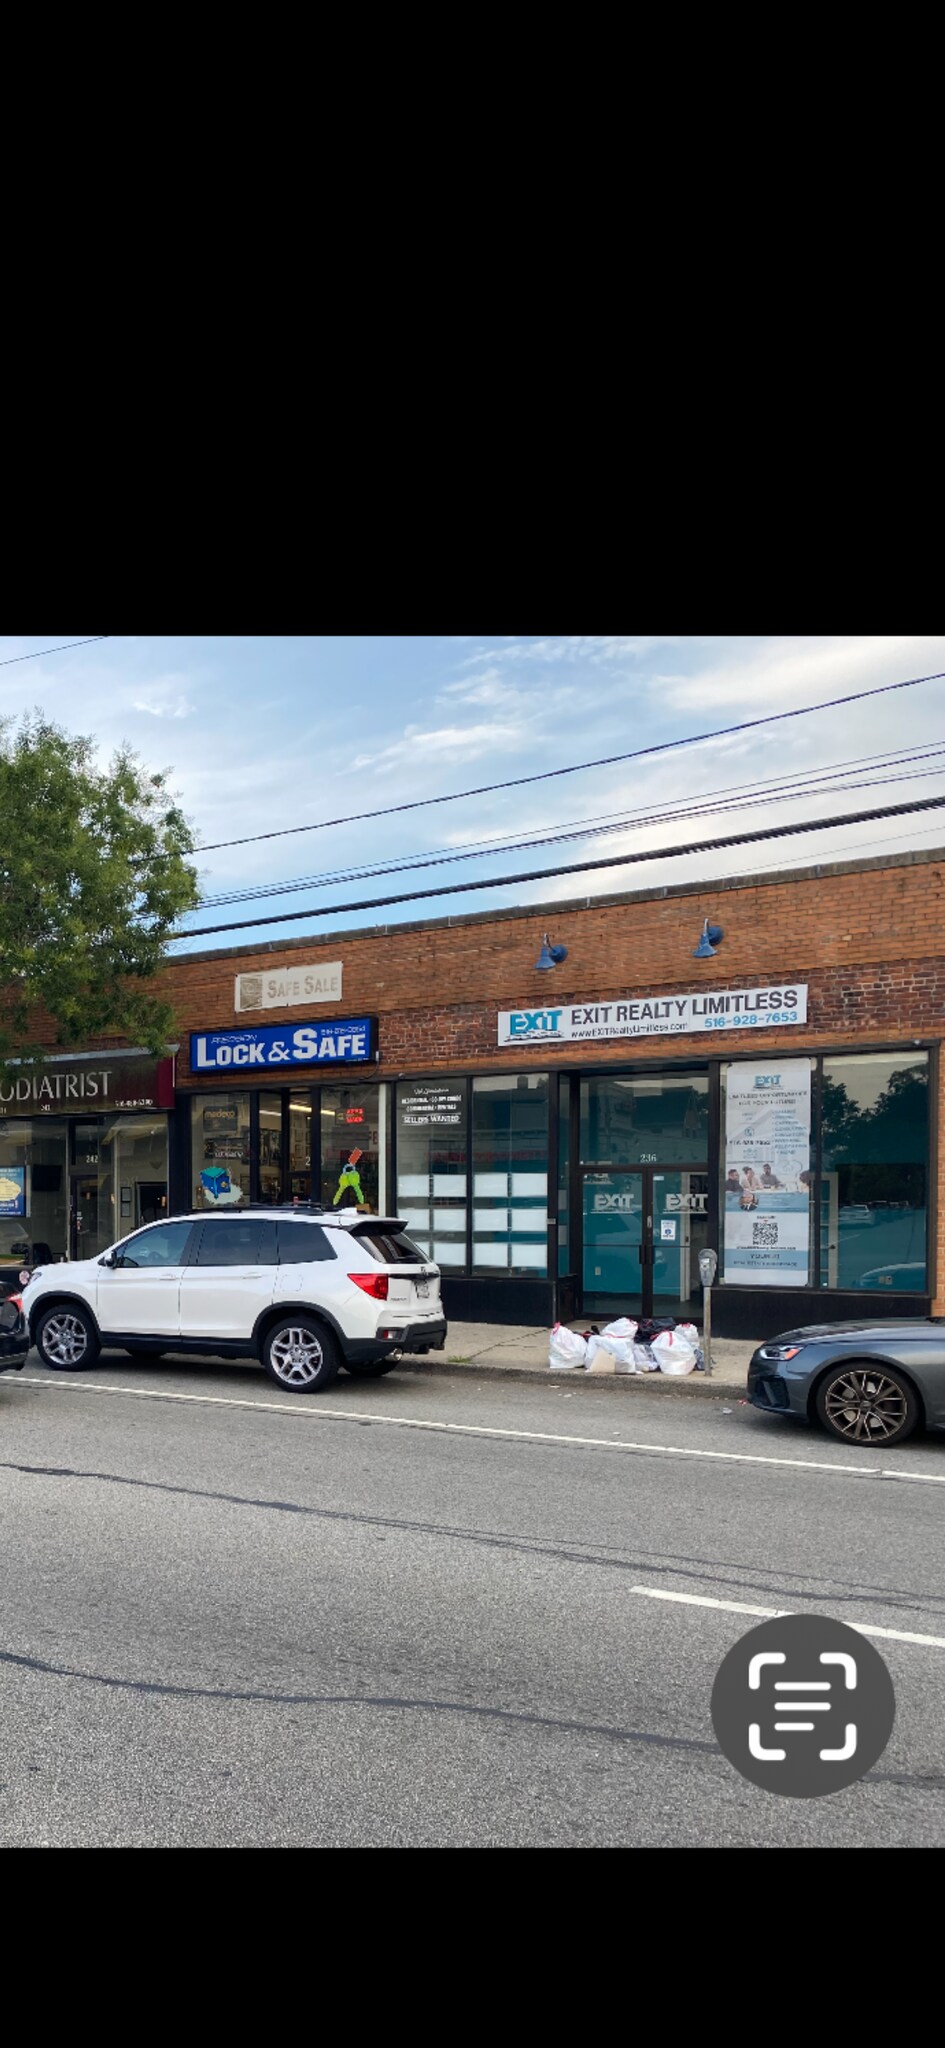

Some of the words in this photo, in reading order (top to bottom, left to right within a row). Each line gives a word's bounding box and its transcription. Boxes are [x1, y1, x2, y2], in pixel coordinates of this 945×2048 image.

[267, 979, 300, 999] SAFE
[304, 975, 338, 995] SALE
[571, 1005, 612, 1025] EXIT
[616, 999, 688, 1022] REALTY
[692, 989, 798, 1015] LIMITLESS
[704, 1011, 798, 1028] 516-928-7653
[197, 1037, 266, 1067] LOCK
[268, 1041, 290, 1062] &
[293, 1028, 366, 1059] SAFE
[86, 1154, 99, 1164] 242
[640, 1153, 657, 1163] 236
